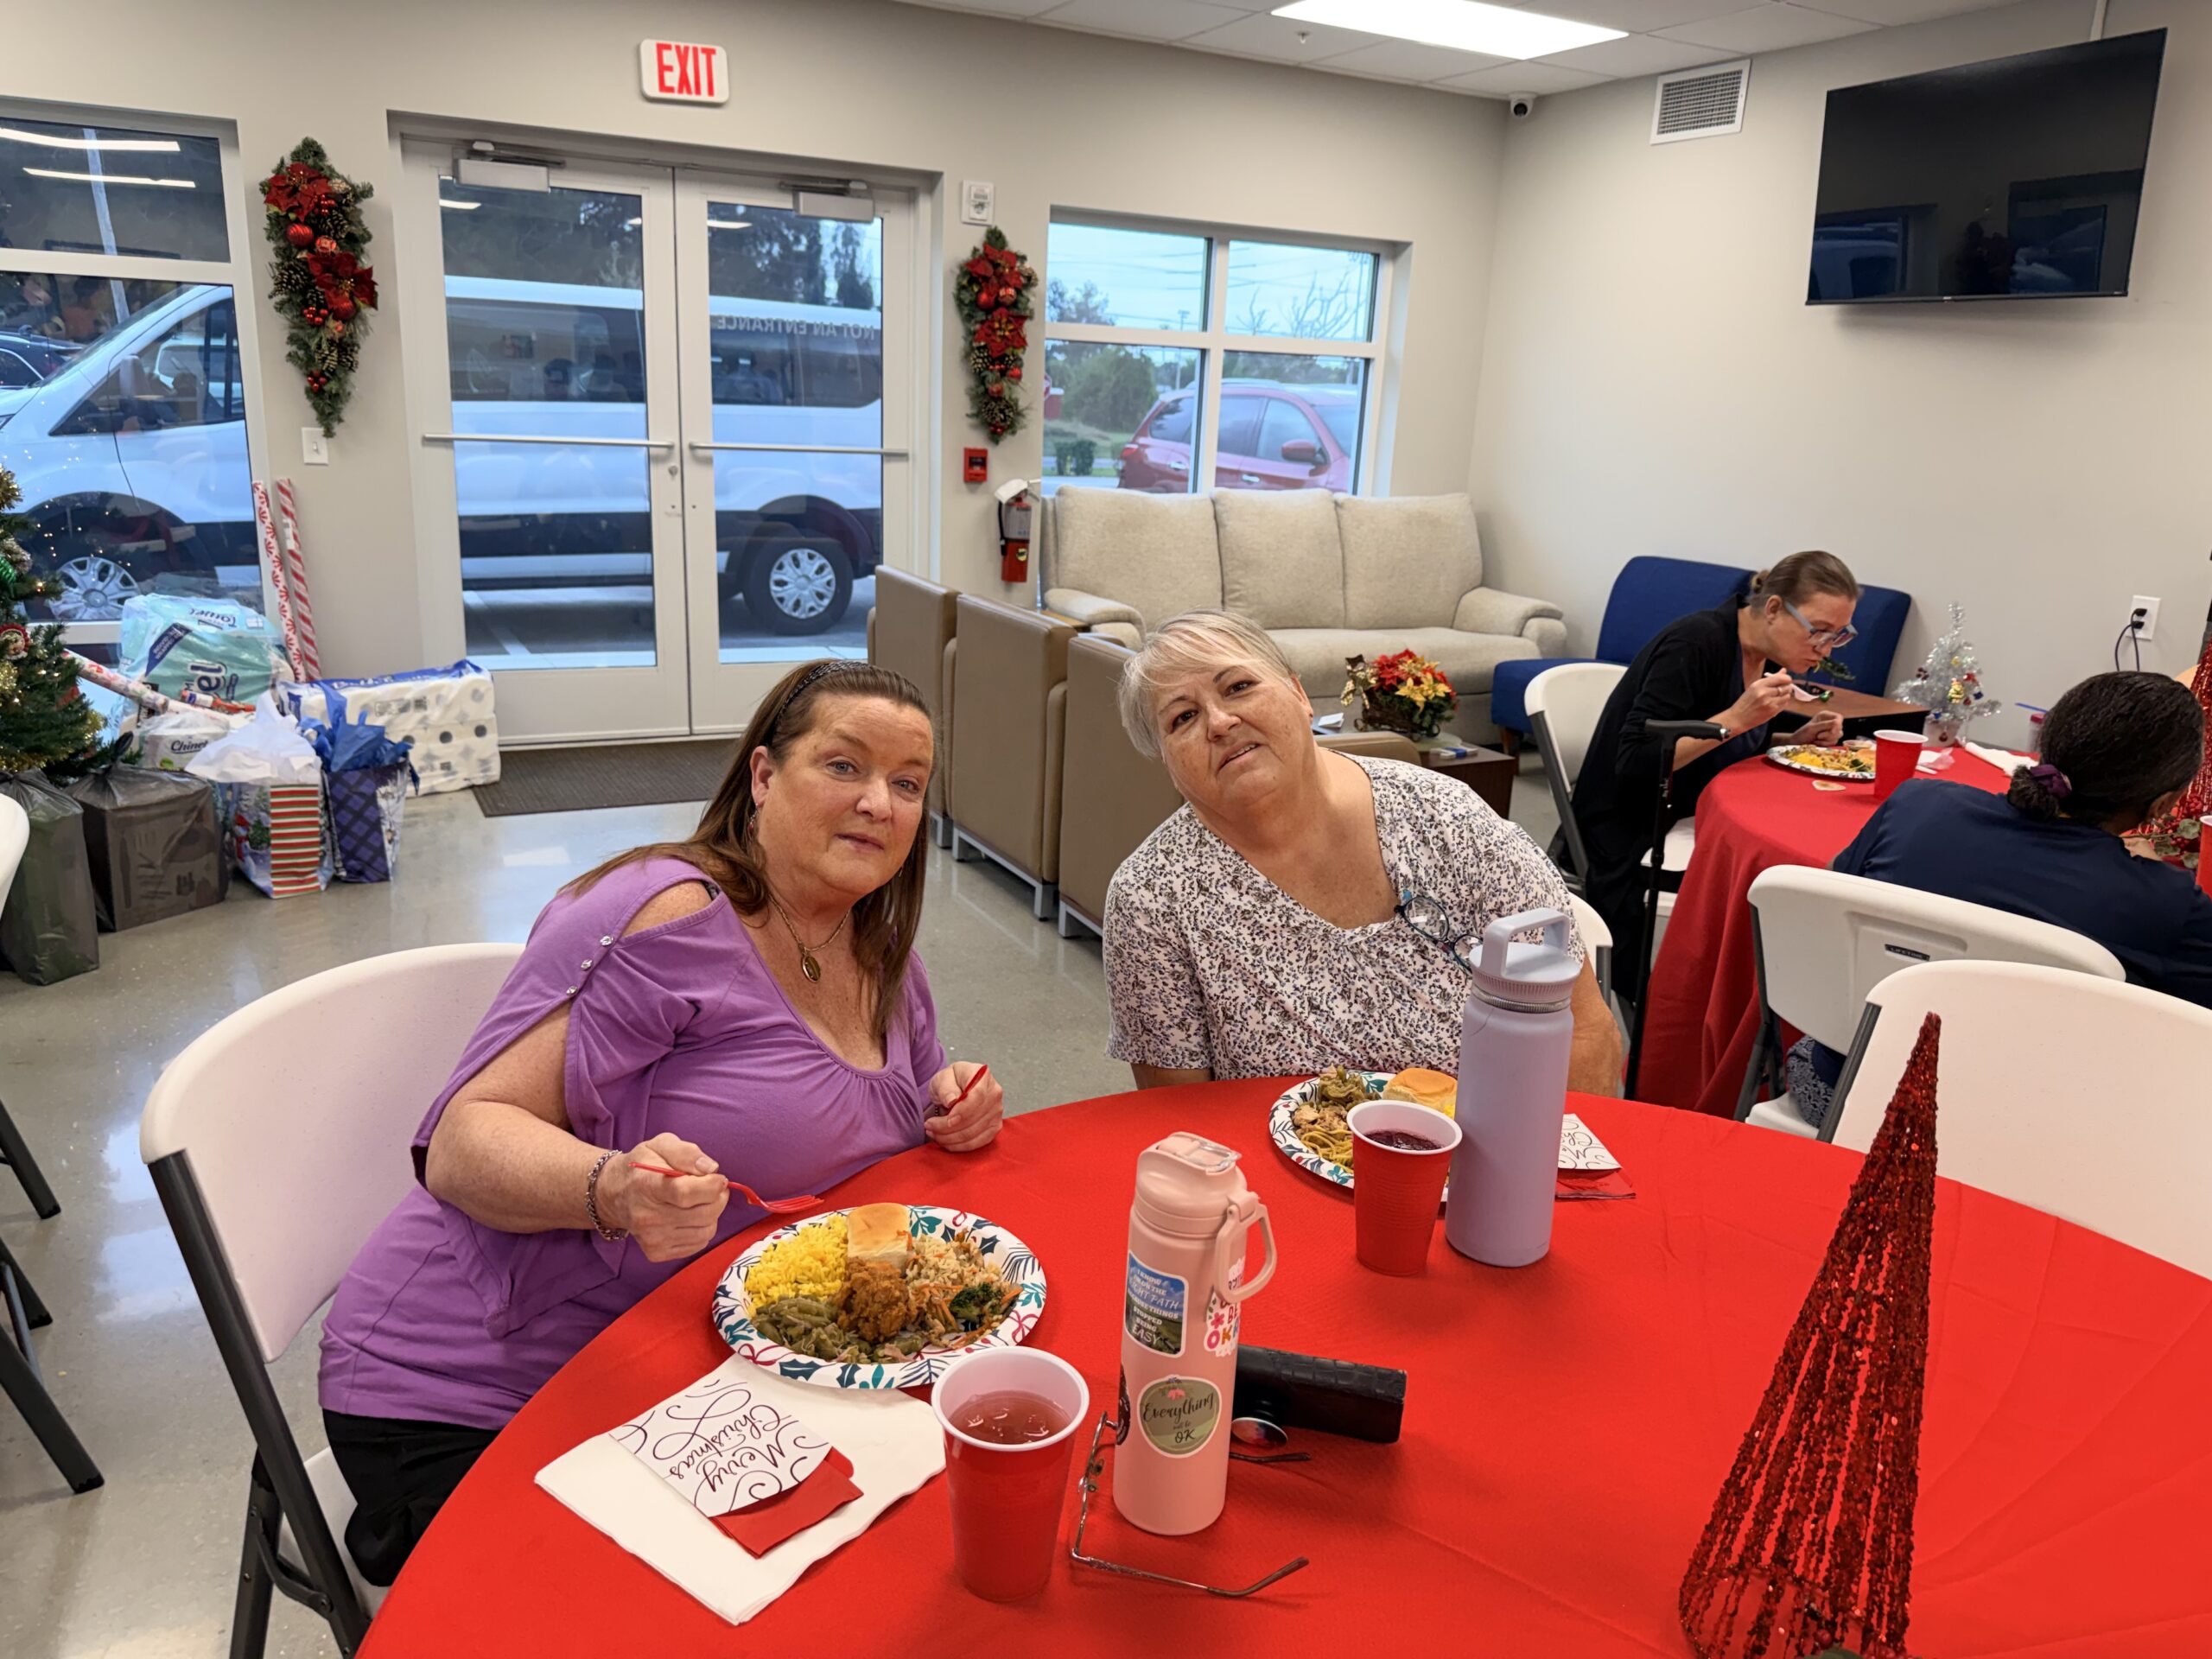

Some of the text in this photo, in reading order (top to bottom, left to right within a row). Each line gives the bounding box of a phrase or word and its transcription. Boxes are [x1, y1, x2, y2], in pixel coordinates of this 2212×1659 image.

[656, 42, 716, 97] EXIT
[1150, 1294, 1179, 1310] PATH
[1132, 1323, 1162, 1345] EASY
[1143, 1393, 1214, 1423] Everything
[670, 1404, 781, 1480] Christmas
[1174, 1428, 1197, 1444] OK
[696, 1430, 790, 1493] Merry
